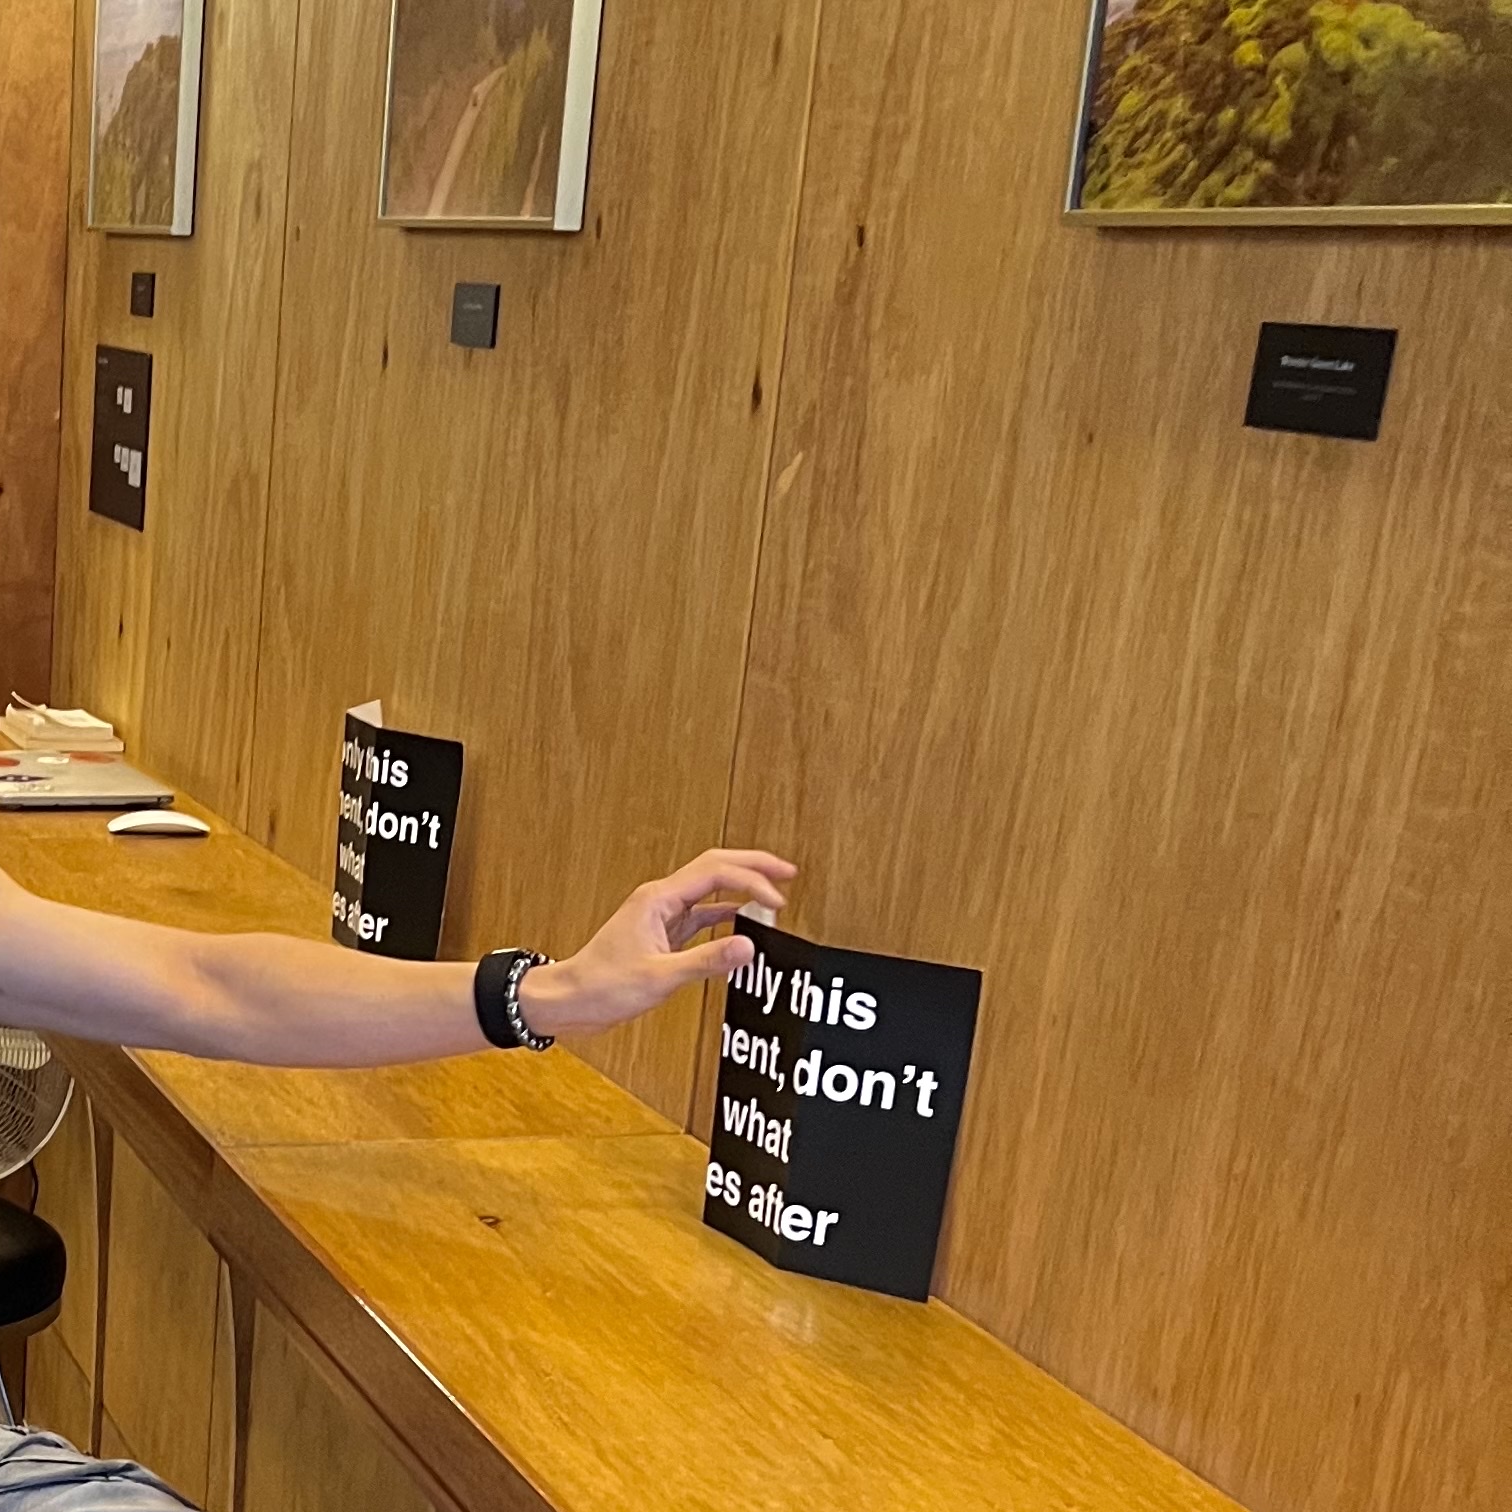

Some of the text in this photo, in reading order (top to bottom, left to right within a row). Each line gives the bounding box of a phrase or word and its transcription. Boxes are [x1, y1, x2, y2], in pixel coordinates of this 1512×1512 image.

[365, 746, 409, 788] this
[365, 801, 441, 850] don't
[339, 841, 366, 884] what
[727, 952, 878, 1031] nly this
[792, 1049, 940, 1118] don't
[723, 1096, 792, 1164] what
[748, 1183, 839, 1247] after
